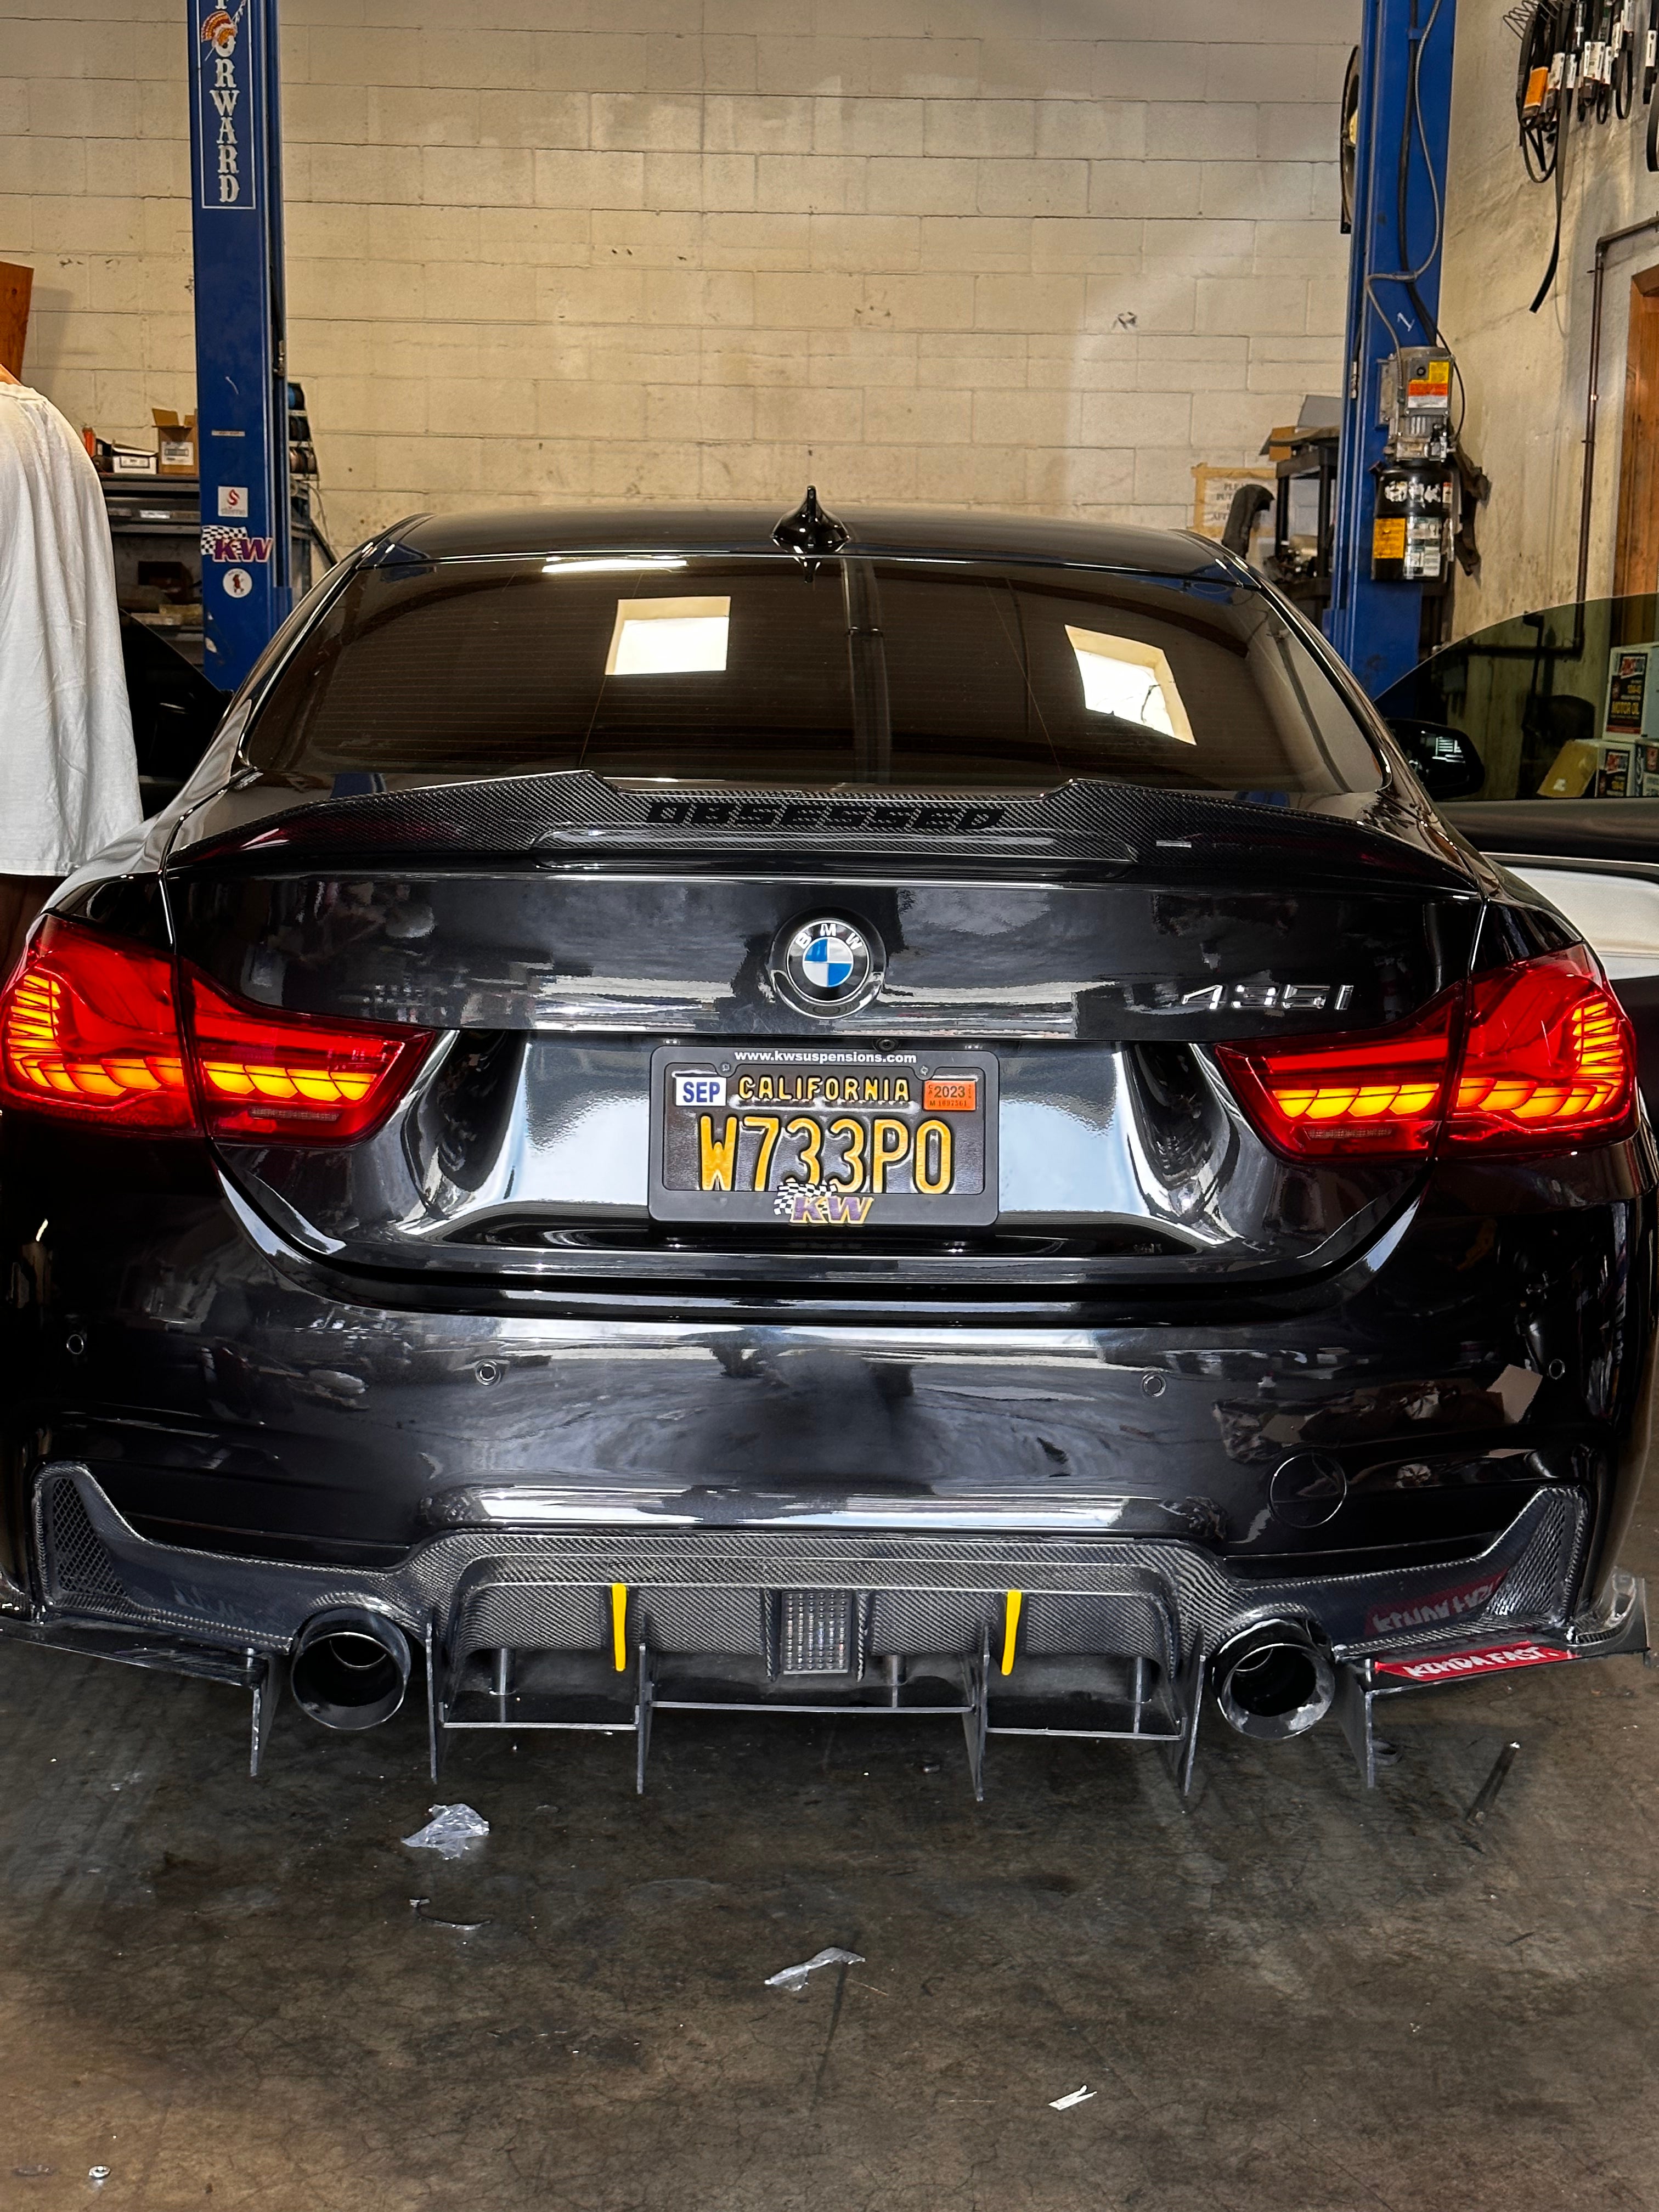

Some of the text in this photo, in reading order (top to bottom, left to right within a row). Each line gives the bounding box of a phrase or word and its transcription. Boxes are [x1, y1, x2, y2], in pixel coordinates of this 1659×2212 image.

[213, 537, 273, 562] KW
[647, 801, 1005, 830] OBSESSED
[795, 923, 861, 950] BMW
[735, 1050, 917, 1064] www.kwsuspensions.com
[682, 1081, 721, 1103] SEP
[738, 1076, 910, 1102] CALIFORNIA
[934, 1086, 965, 1098] 2023
[788, 1196, 873, 1224] KW
[1403, 1656, 1488, 1677] KINDA
